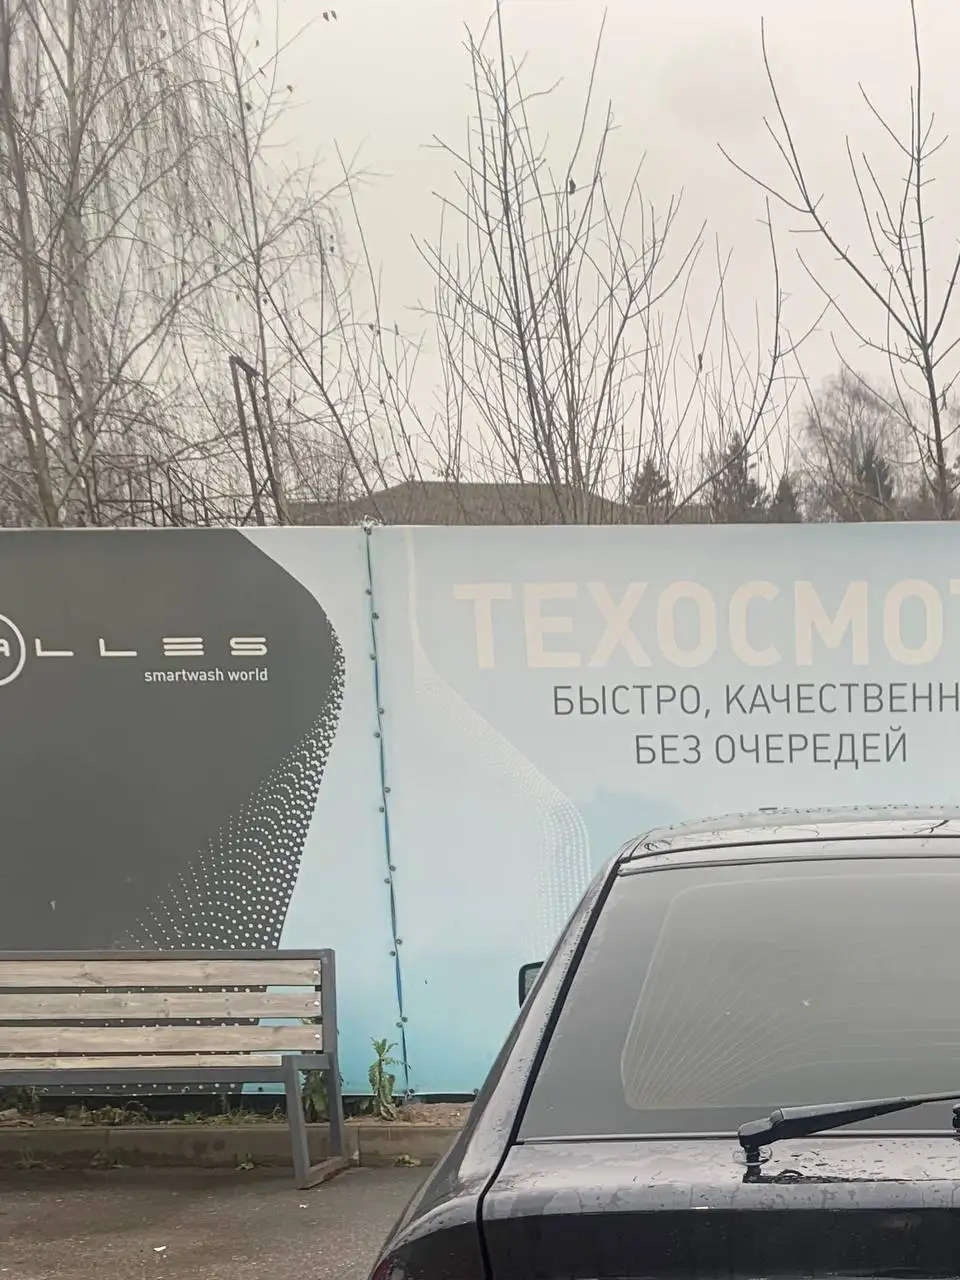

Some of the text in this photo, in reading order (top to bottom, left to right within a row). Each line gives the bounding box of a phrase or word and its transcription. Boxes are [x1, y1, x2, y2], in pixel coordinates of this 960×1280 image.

[0, 636, 268, 657] LLES
[144, 668, 268, 682] smartwash world
[552, 684, 711, 719] БЫСТРО,
[635, 726, 907, 770] БЕЗ ОЧЕРЕДЕЙ
